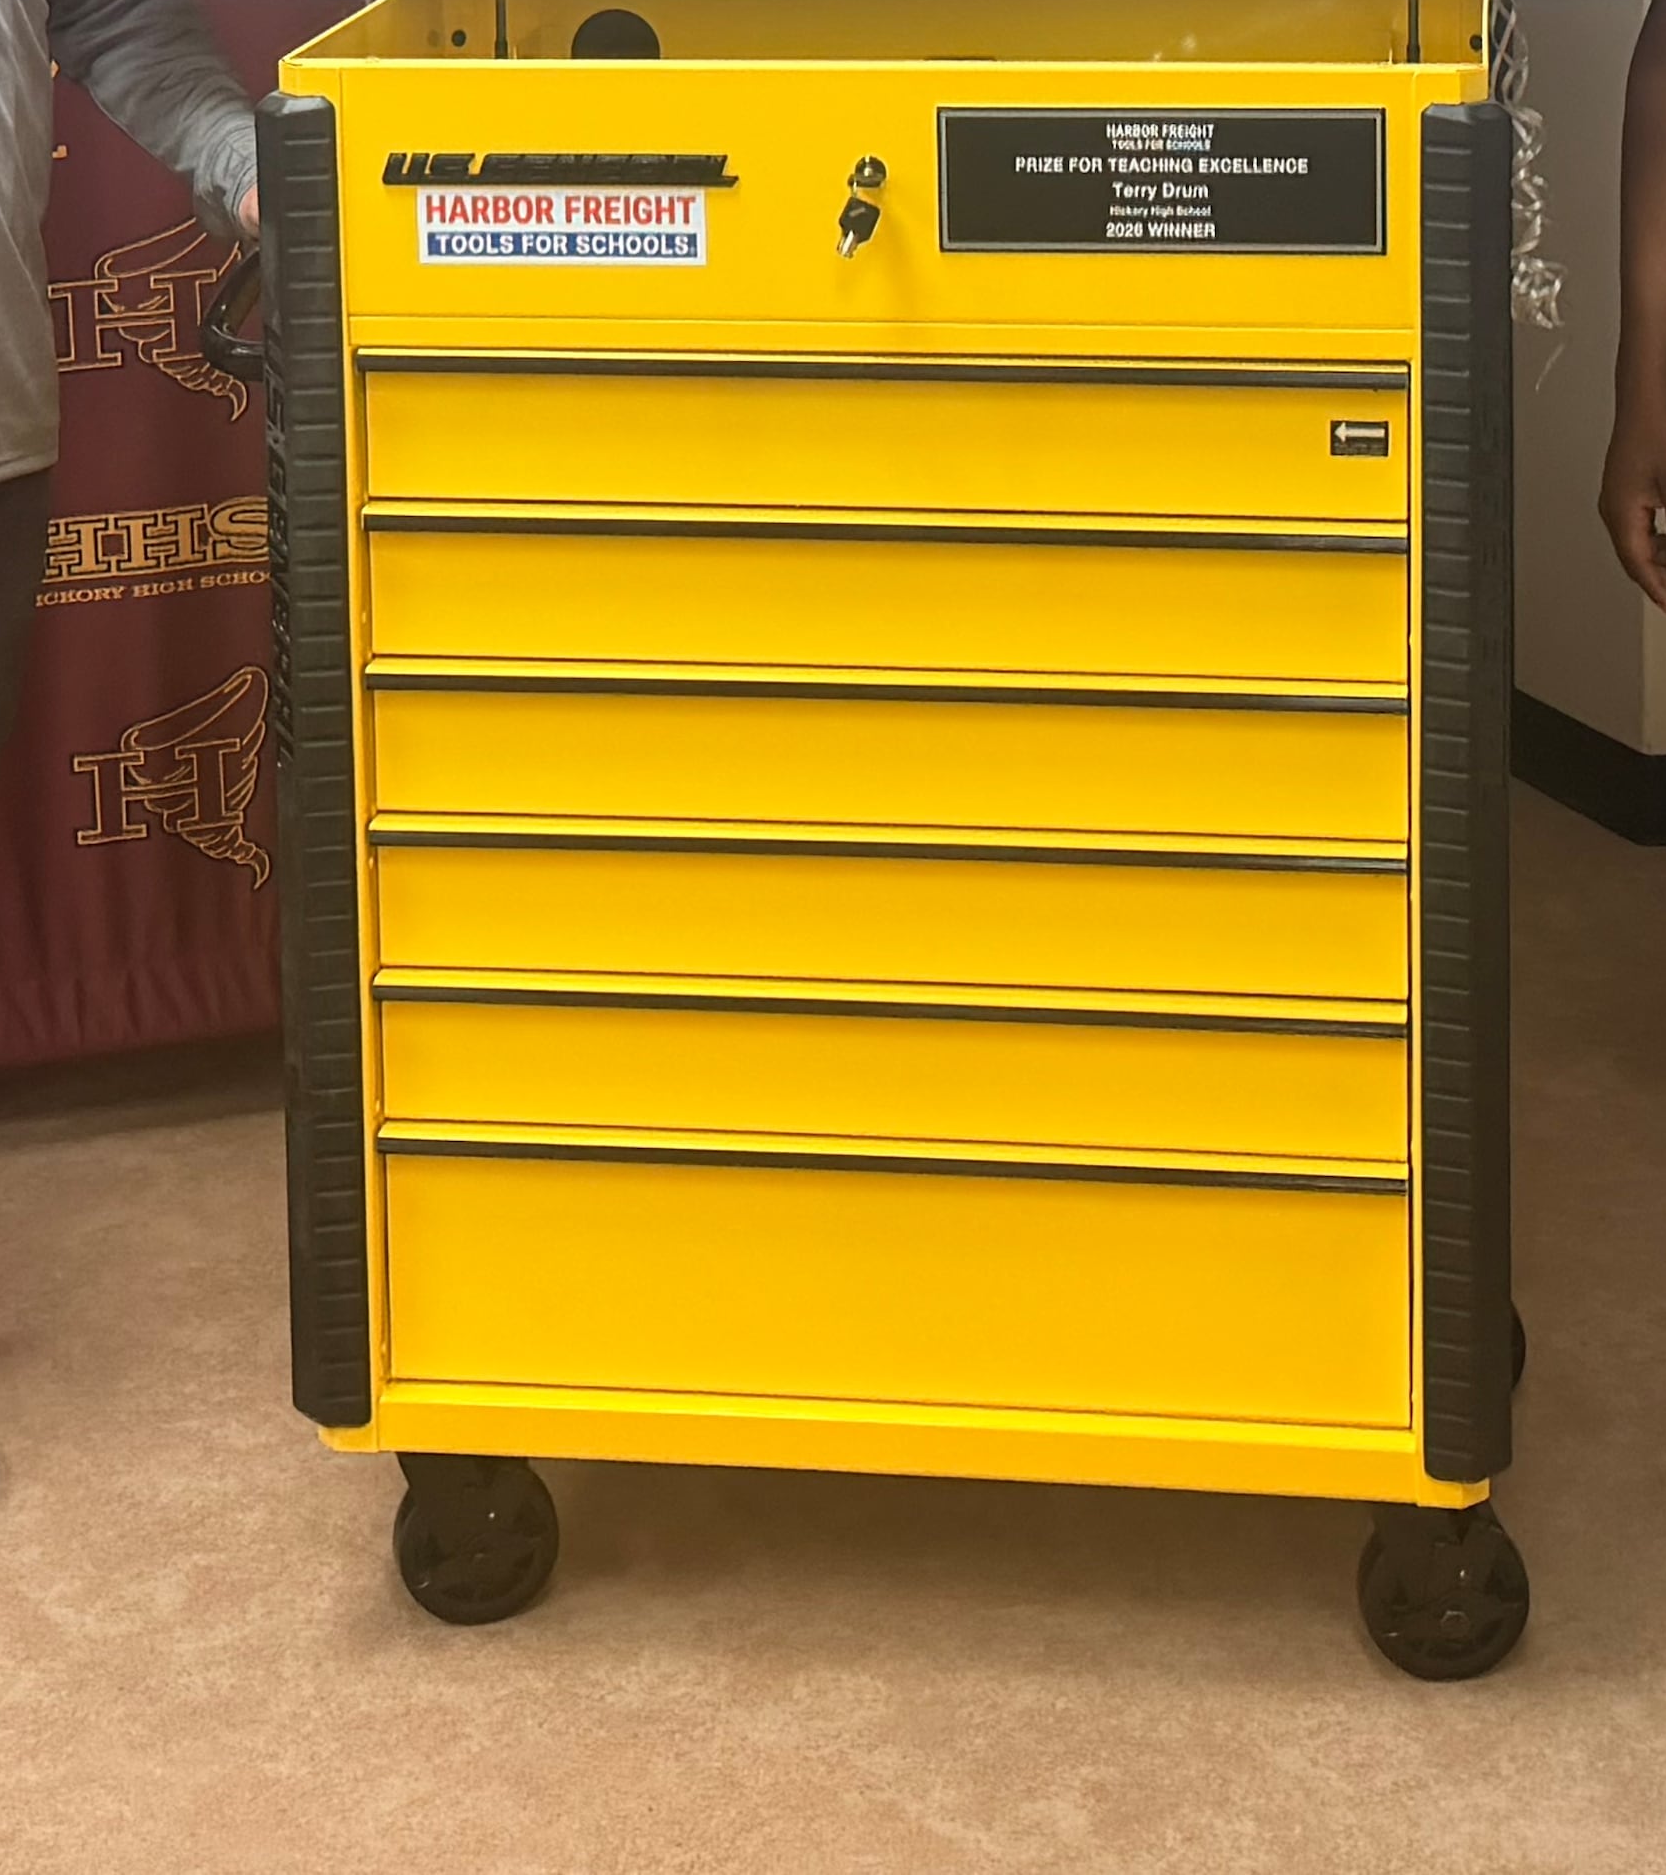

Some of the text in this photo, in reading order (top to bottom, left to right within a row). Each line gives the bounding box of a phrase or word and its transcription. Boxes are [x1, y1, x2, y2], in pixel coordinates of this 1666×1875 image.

[1015, 157, 1309, 174] PRIZE FOR TEACHING EXCELLENCE
[1112, 182, 1208, 201] Terry Drum
[426, 195, 696, 225] HARBOR FREIGHT
[1148, 223, 1216, 238] WINNER
[436, 234, 689, 255] TOOLS FOR SCHOOLS
[35, 571, 270, 608] ICKORY HIGH SCHO
